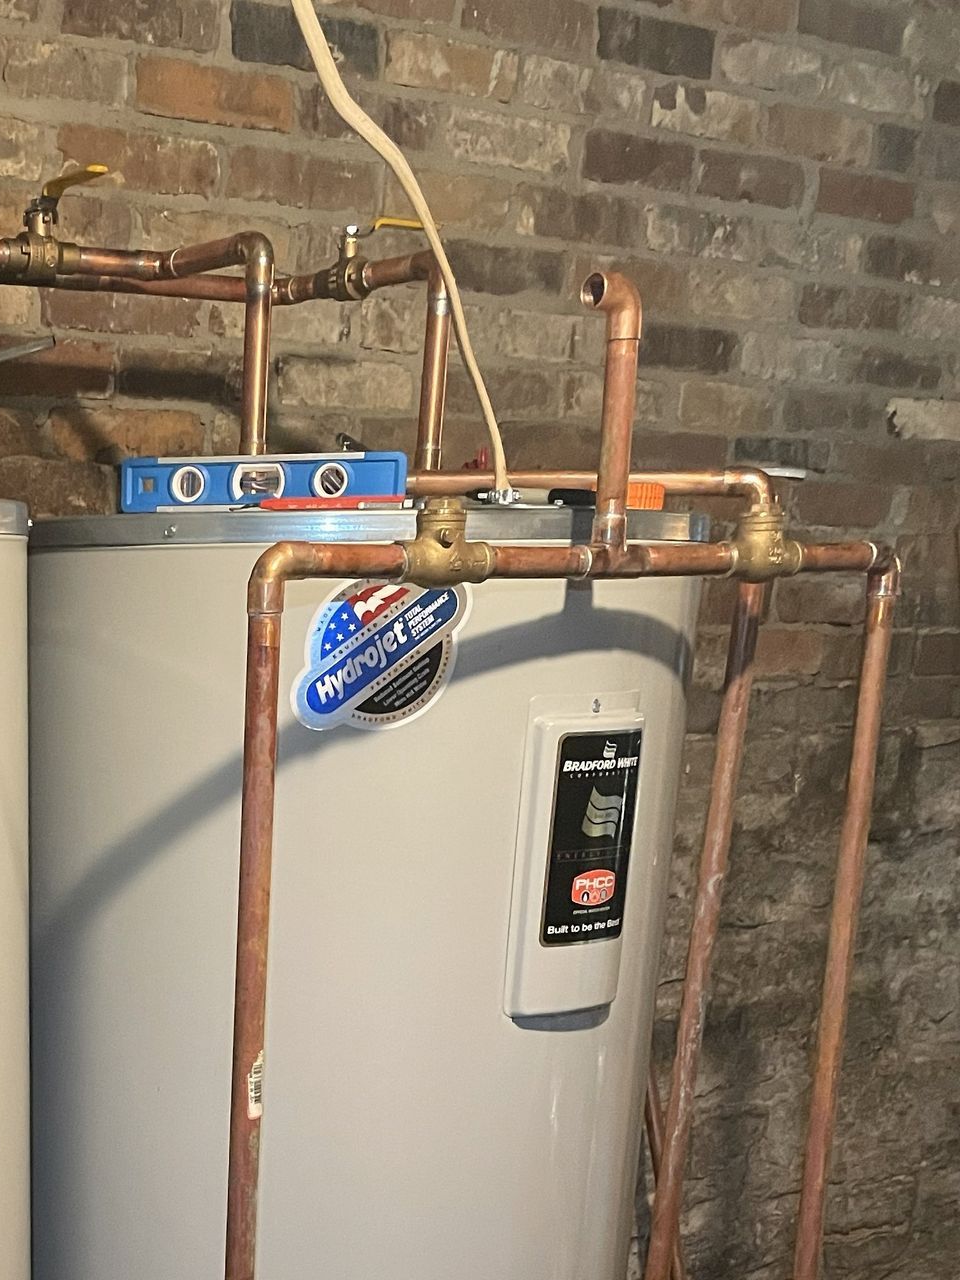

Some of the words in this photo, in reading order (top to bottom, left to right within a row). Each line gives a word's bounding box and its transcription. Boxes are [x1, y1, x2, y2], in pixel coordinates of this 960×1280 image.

[405, 604, 423, 622] TOTAL
[408, 592, 450, 629] PERFORMANCE
[411, 614, 435, 636] SYSTEM
[316, 621, 407, 704] Hydrojet
[563, 759, 616, 772] BRADFORD
[616, 756, 638, 769] WHITE
[575, 876, 614, 891] PHCC
[547, 925, 569, 934] Built
[570, 925, 580, 933] to
[581, 924, 593, 932] be
[594, 922, 606, 930] the
